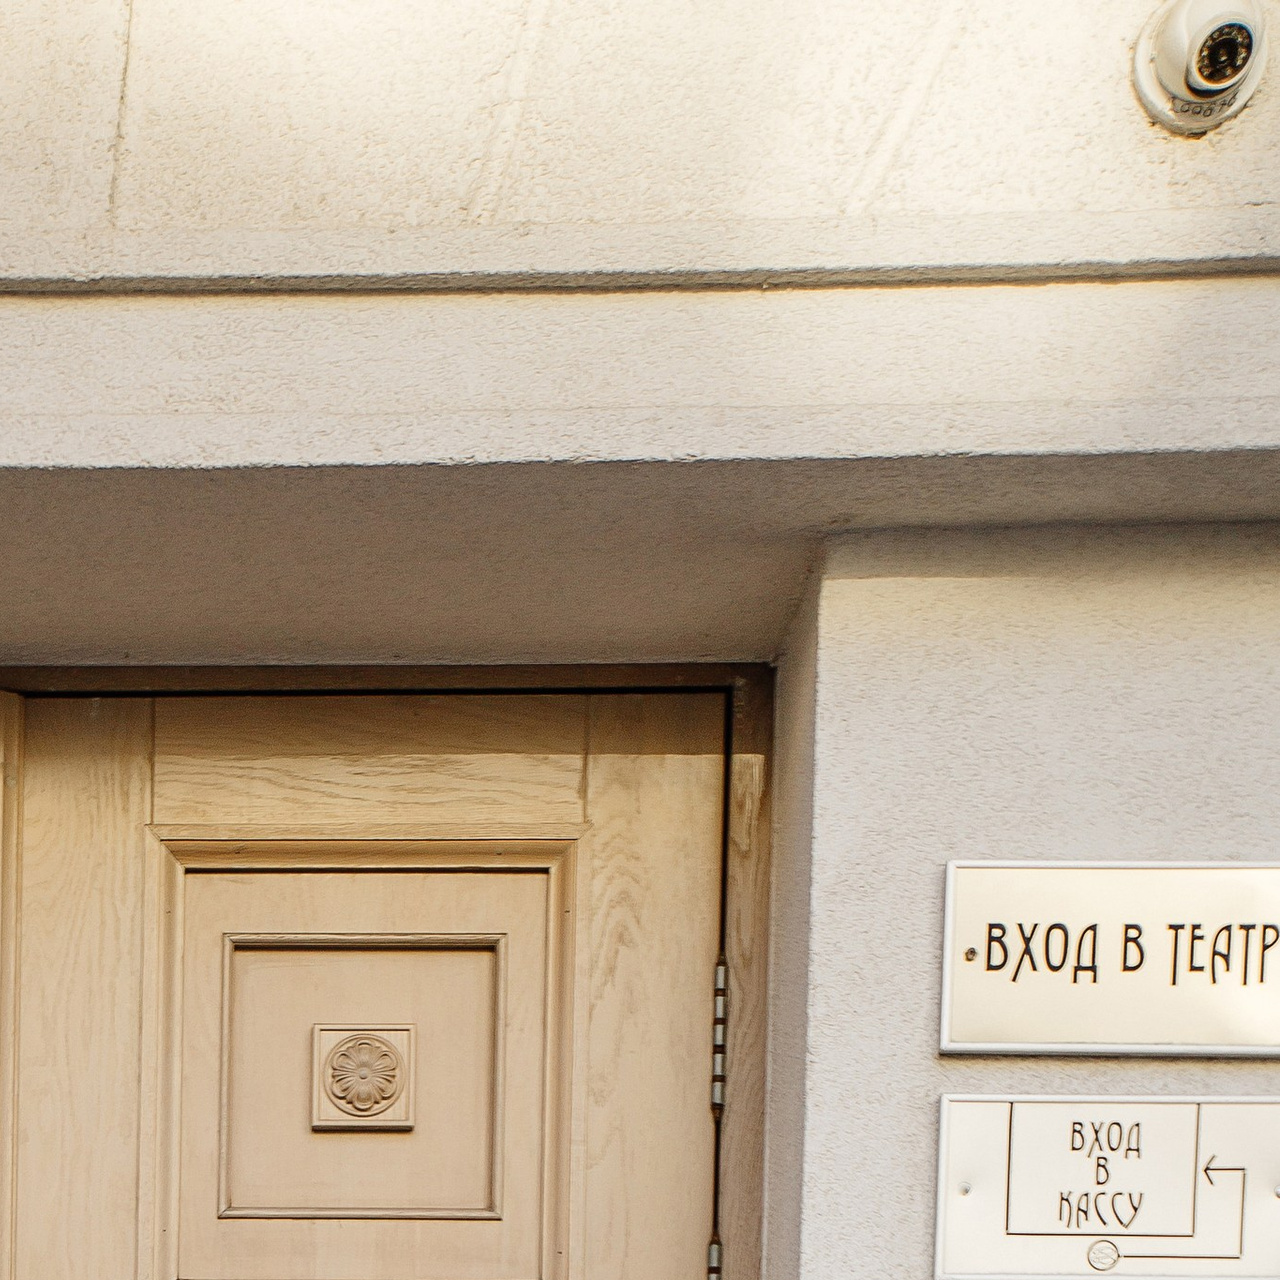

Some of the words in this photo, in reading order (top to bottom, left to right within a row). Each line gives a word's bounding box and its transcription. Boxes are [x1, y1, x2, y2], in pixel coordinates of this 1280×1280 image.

[986, 922, 1099, 984] ВХОД
[1122, 923, 1146, 972] В
[1168, 923, 1280, 986] ТЕАТР
[1071, 1121, 1140, 1159] ВХОД
[1096, 1156, 1110, 1186] В
[1059, 1191, 1143, 1229] КАССУ
